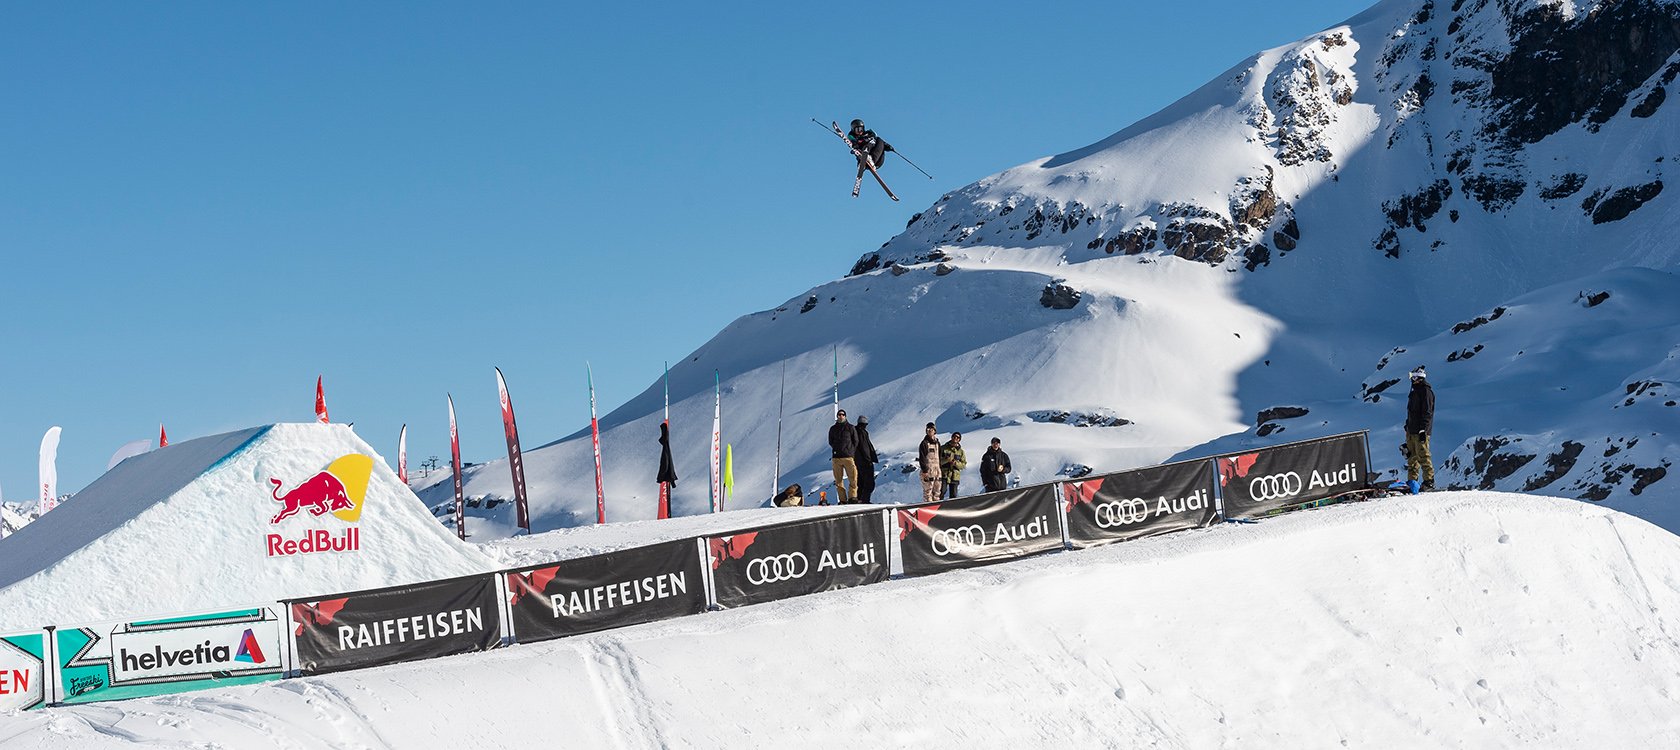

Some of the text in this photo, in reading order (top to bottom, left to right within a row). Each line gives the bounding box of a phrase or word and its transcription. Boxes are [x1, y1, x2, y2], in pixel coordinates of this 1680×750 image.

[1308, 463, 1357, 490] Audi
[1154, 489, 1209, 517] Audi
[993, 515, 1049, 544] Audi
[817, 543, 876, 572] Audi
[551, 571, 687, 618] RAIFFEISEN
[338, 607, 483, 650] RAIFFEISEN
[120, 640, 230, 671] helvetia
